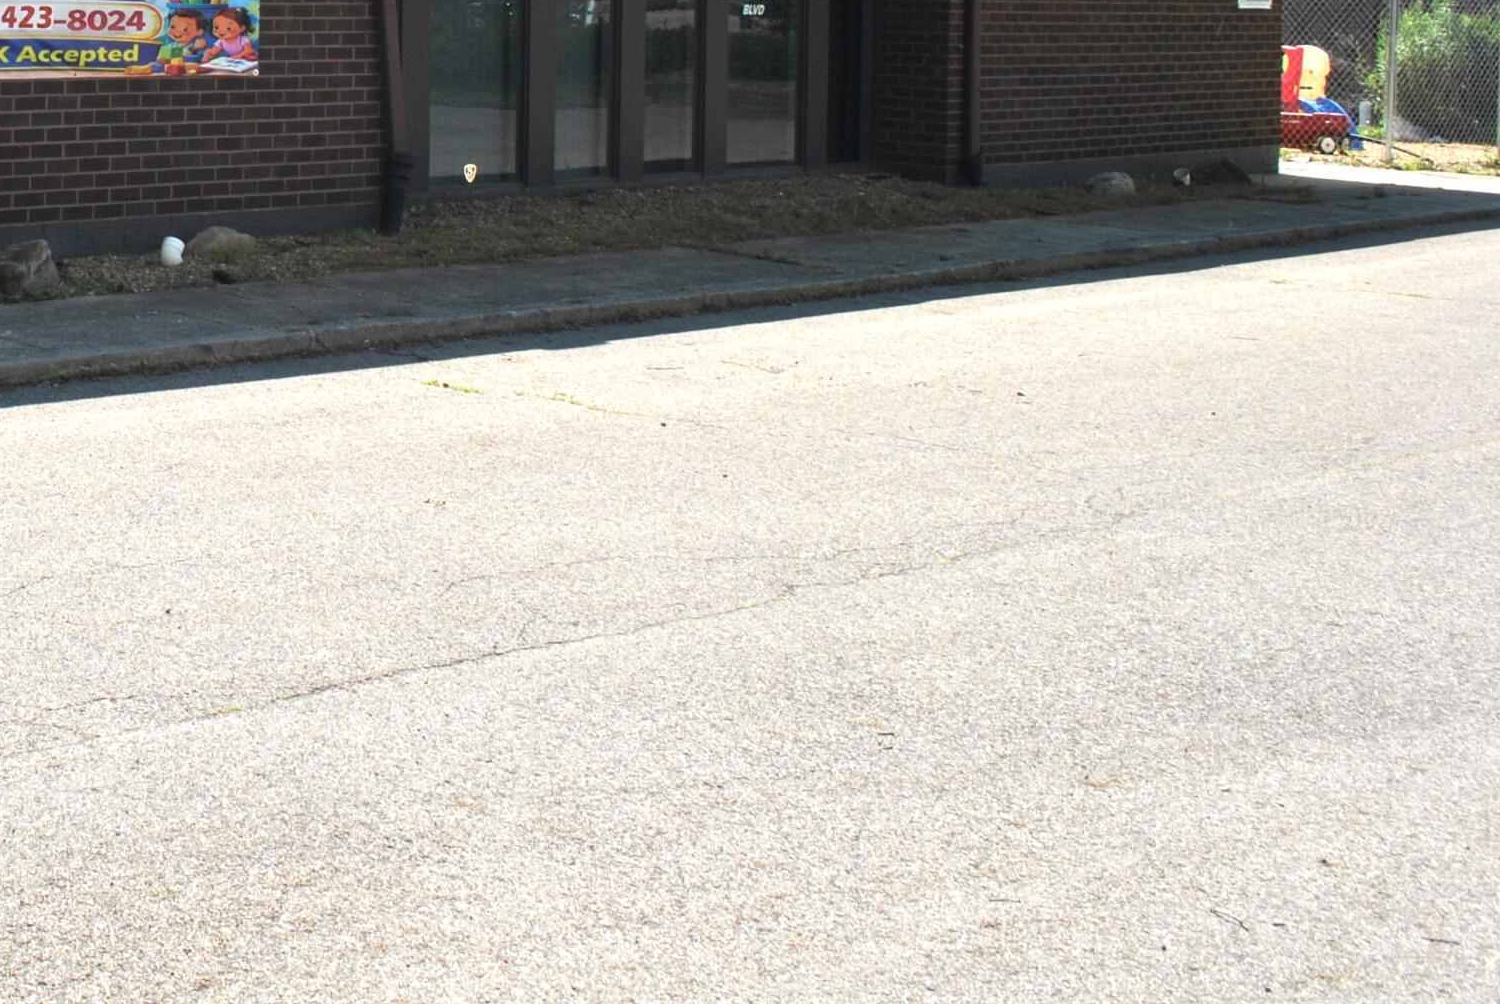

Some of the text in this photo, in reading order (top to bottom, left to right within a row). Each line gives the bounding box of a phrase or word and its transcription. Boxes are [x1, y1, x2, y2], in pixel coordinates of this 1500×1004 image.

[1, 5, 147, 32] 423-8024
[742, 4, 765, 16] BLVD
[16, 44, 140, 67] Accepted
